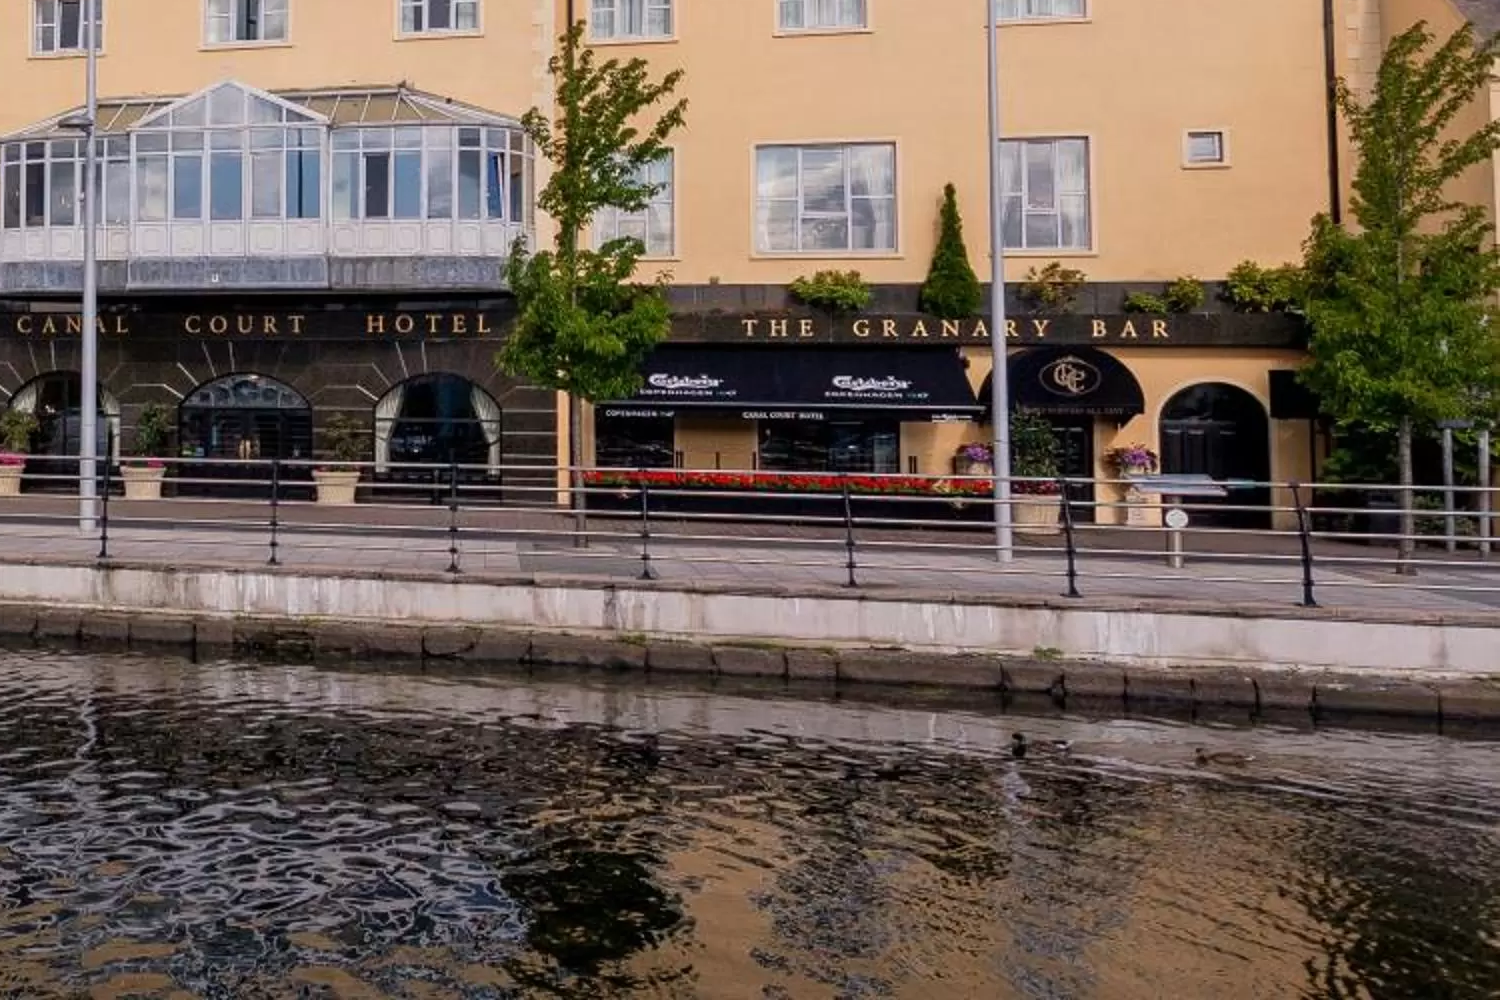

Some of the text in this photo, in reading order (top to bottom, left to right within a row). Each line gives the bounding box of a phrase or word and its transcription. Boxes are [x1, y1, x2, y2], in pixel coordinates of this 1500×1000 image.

[17, 315, 492, 334] CANAL COURT HOTEL
[742, 319, 1169, 337] THE GRANARY BAR
